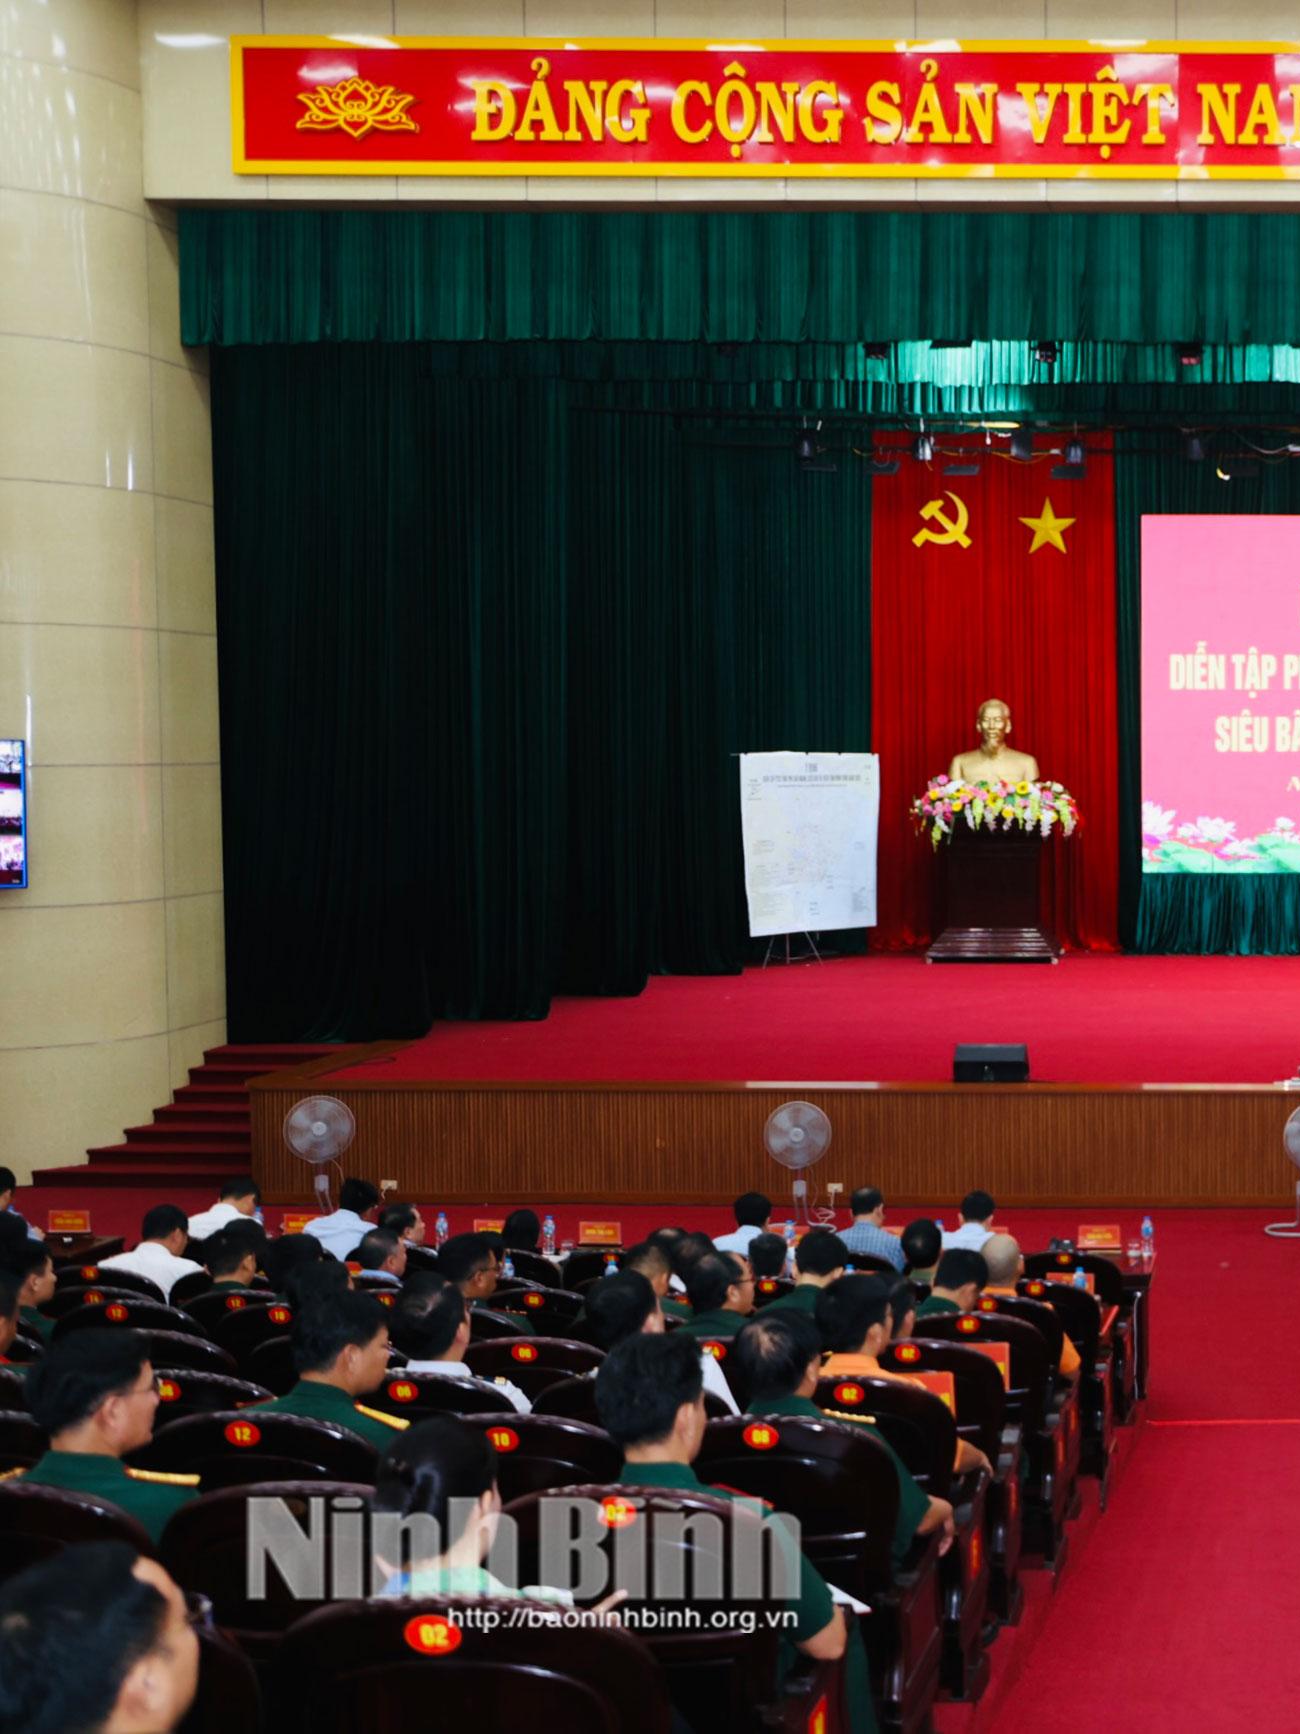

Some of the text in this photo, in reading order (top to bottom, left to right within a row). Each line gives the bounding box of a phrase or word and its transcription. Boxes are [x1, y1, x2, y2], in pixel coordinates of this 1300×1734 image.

[471, 57, 651, 143] ĐẢNG
[670, 61, 844, 158] CỘNG
[864, 58, 998, 145] SẢN
[1016, 65, 1176, 159] VIỆT
[1169, 640, 1227, 691] DIỄN
[1231, 646, 1278, 699] TẬP
[1214, 708, 1270, 753] SIÊU
[234, 1426, 251, 1441] 12
[493, 1432, 511, 1447] 10
[419, 1623, 449, 1647] 02
